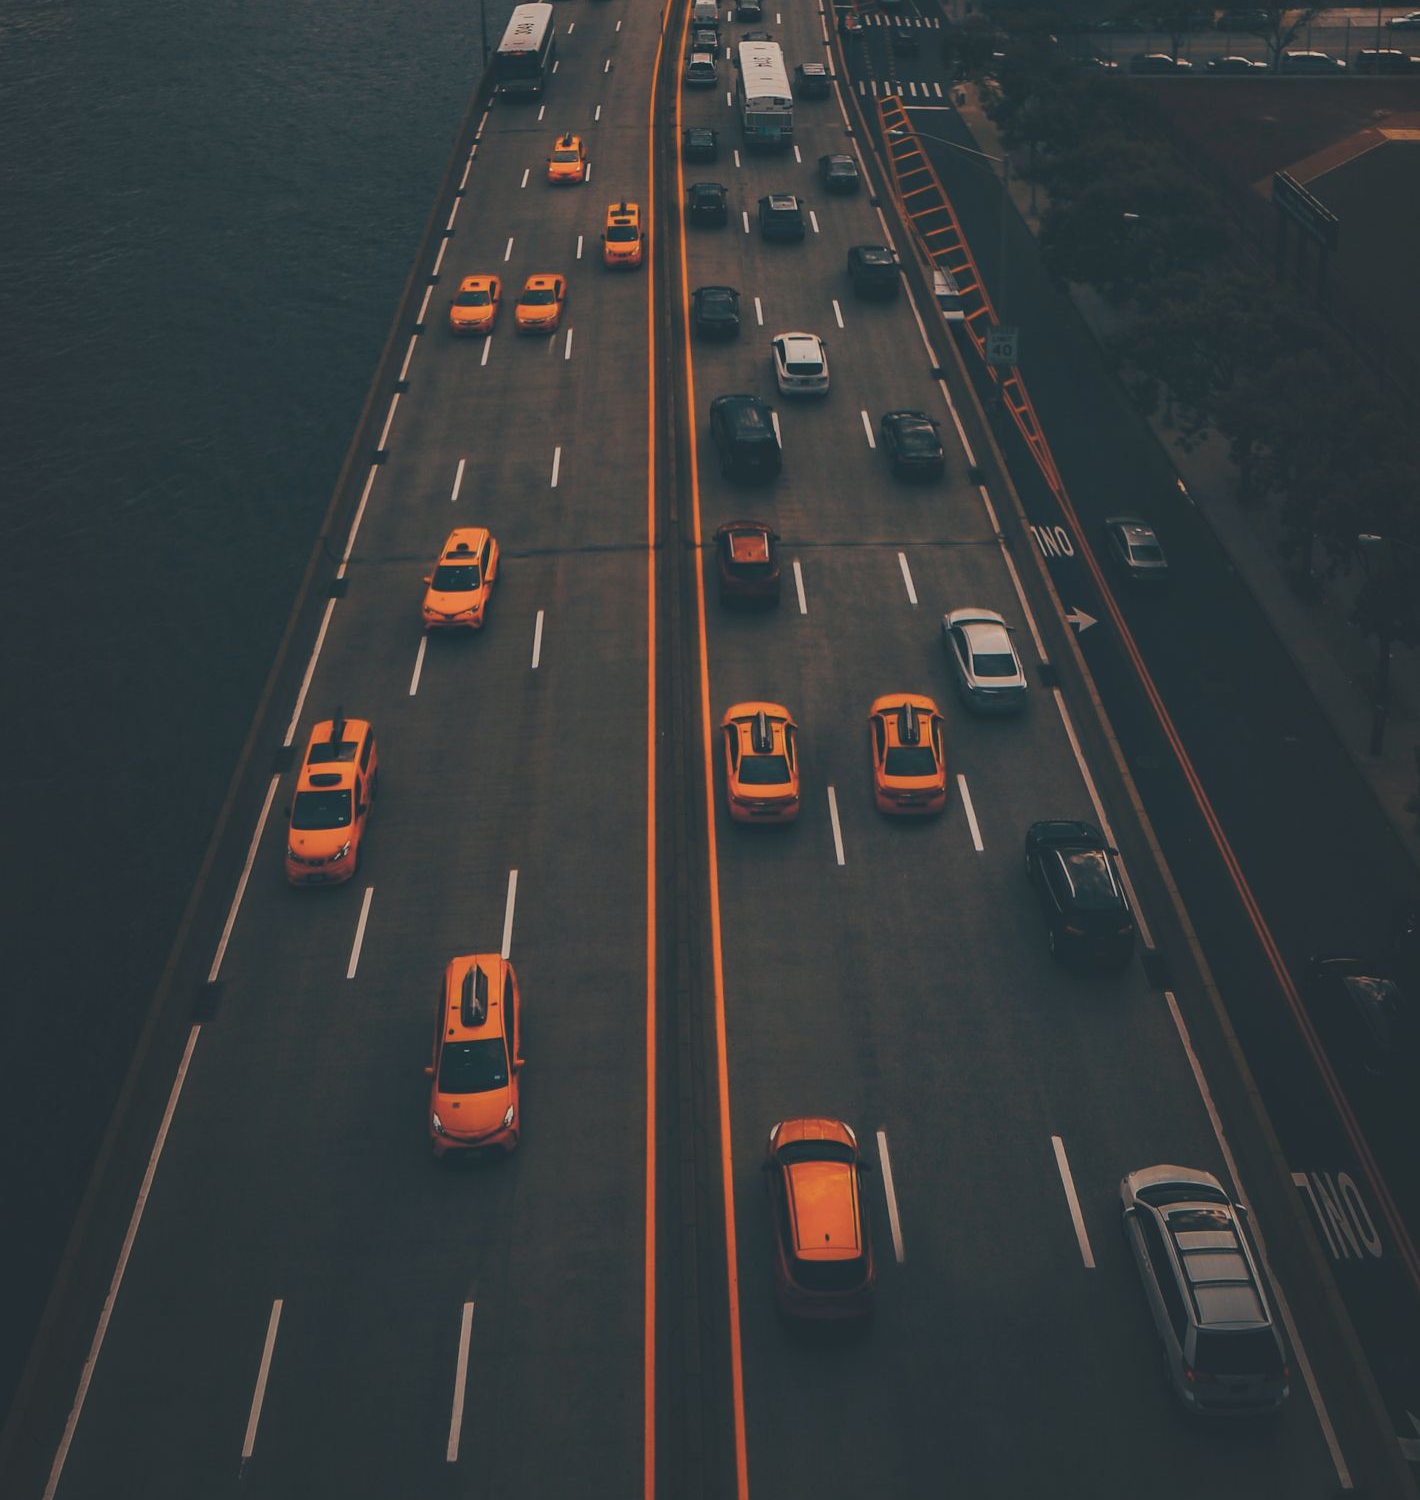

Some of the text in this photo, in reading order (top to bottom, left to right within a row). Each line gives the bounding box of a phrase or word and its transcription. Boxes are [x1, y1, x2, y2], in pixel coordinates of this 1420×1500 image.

[991, 344, 1012, 356] 40
[1030, 526, 1074, 557] ONL
[1290, 1172, 1383, 1260] ONL
